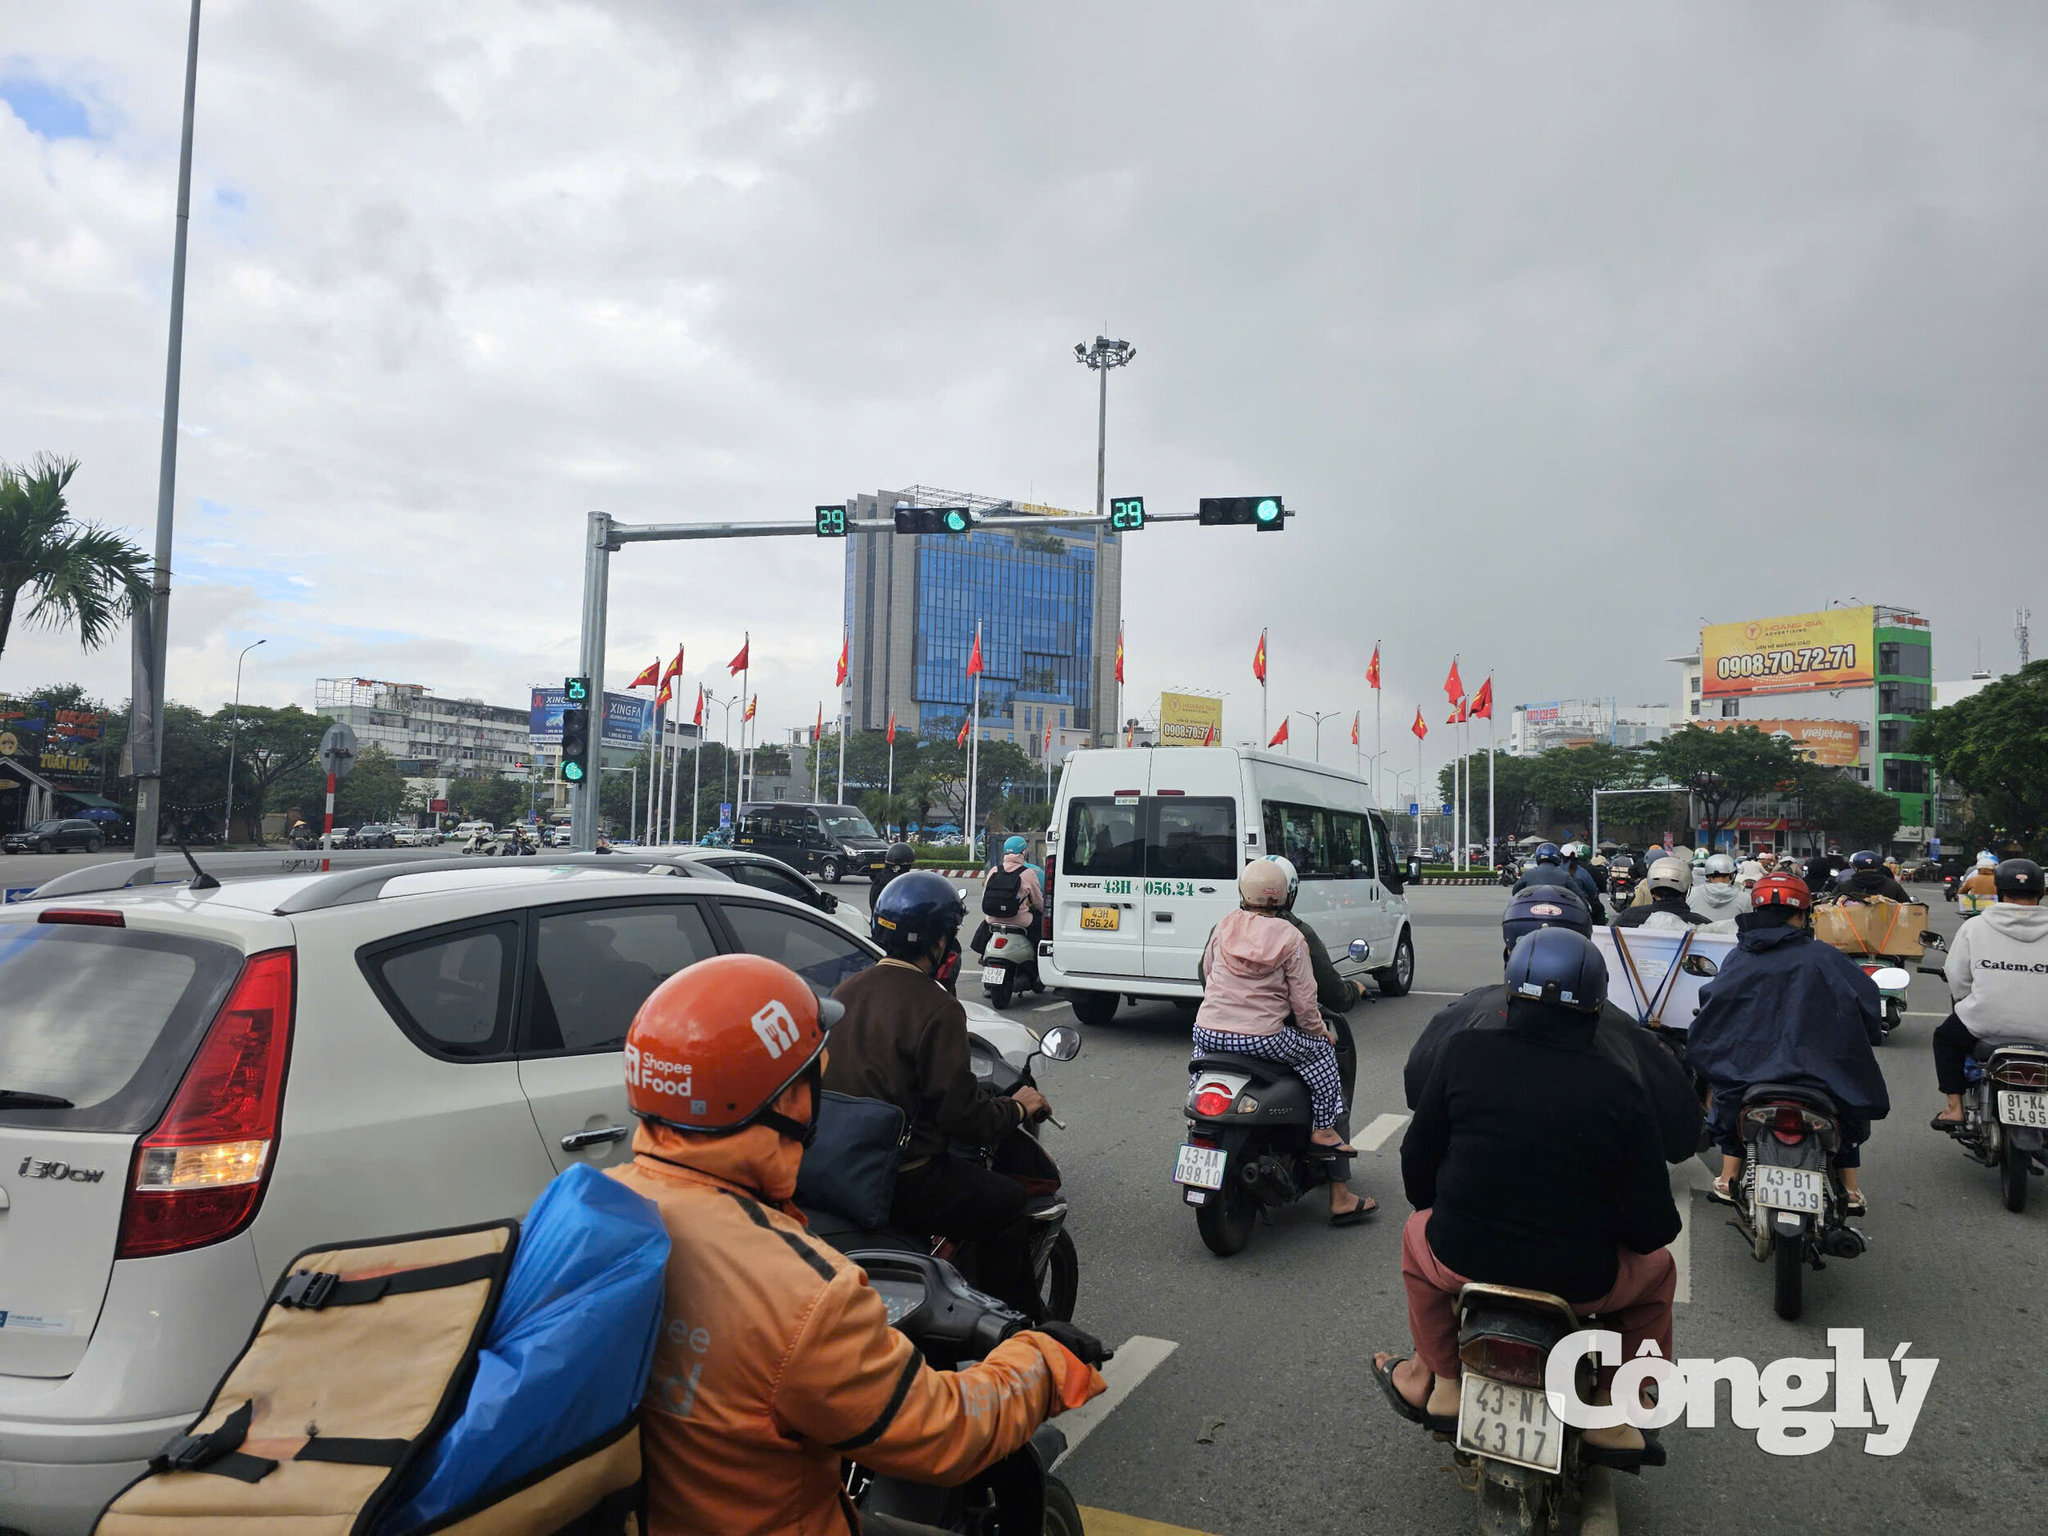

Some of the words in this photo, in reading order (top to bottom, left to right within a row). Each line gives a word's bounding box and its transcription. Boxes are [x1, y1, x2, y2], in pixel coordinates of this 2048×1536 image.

[819, 509, 844, 533] 29
[1114, 502, 1141, 528] 29
[1717, 644, 1855, 679] 0908.70.72.71
[1103, 880, 1131, 894] 43H
[1145, 881, 1194, 896] 056.24
[1084, 919, 1114, 929] 056.24
[1092, 910, 1108, 918] 43H
[642, 1052, 692, 1076] Shopee
[642, 1069, 692, 1097] Food
[2008, 1094, 2045, 1110] 81-K4
[2008, 1109, 2046, 1125] 5495
[1184, 1148, 1218, 1168] 43-AA
[1177, 1164, 1221, 1186] 098.10
[1767, 1169, 1811, 1190] 43-B1
[1760, 1187, 1819, 1210] 011.39
[1476, 1382, 1548, 1426] 43-N1
[1474, 1417, 1546, 1461] 4317
